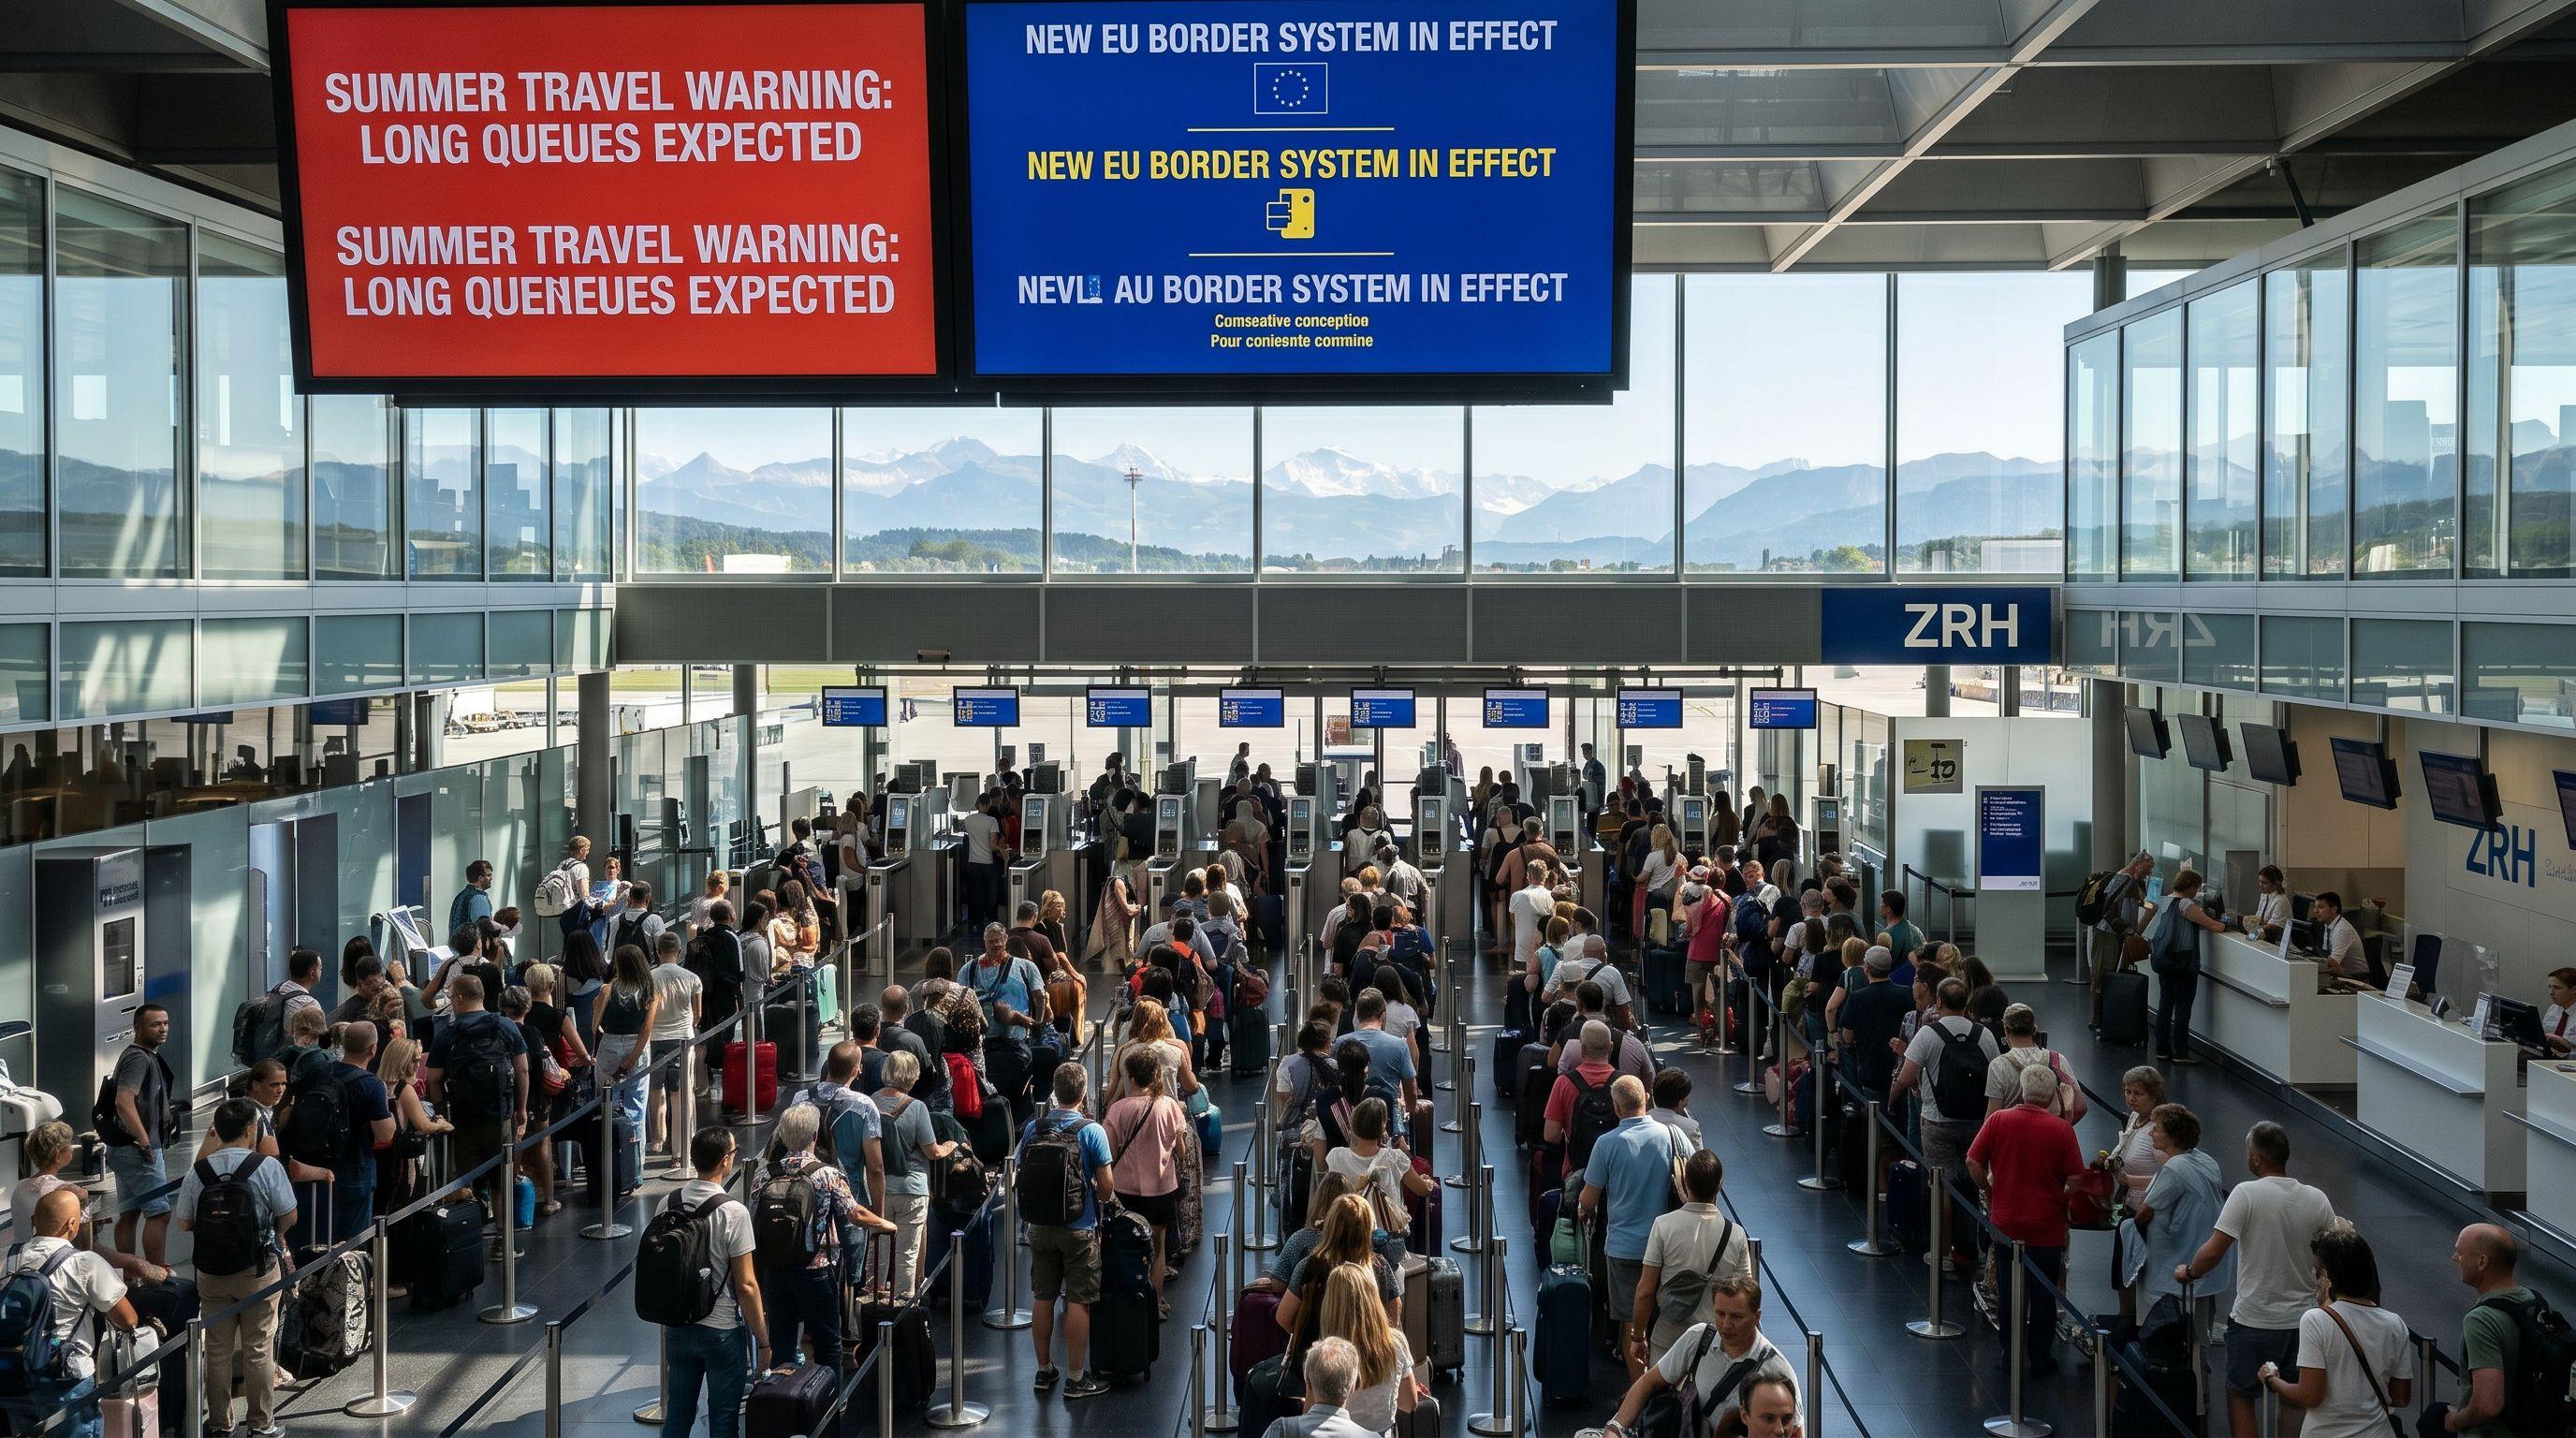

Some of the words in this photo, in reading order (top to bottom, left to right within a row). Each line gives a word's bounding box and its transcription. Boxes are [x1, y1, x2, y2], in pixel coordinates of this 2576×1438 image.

[1027, 23, 1092, 54] NEW
[1103, 23, 1139, 53] EU
[1149, 22, 1269, 53] BORDER
[1279, 22, 1398, 52] SYSTEM
[1410, 22, 1439, 51] IN
[1449, 21, 1558, 51] EFFECT
[325, 72, 507, 113] SUMMER
[518, 71, 674, 111] TRAVEL
[684, 69, 893, 110] WARNING:
[360, 124, 469, 165] LONG
[482, 123, 641, 168] QUEUES
[653, 121, 862, 162] EXPECTED
[1028, 151, 1094, 181] NEW
[1104, 150, 1140, 180] EU
[1149, 150, 1270, 180] BORDER
[1280, 149, 1399, 179] SYSTEM
[1409, 148, 1439, 178] IN
[1449, 147, 1557, 178] EFFECT
[336, 226, 518, 266] SUMMER
[527, 225, 684, 265] TRAVEL
[693, 223, 900, 264] WARNING:
[344, 276, 452, 316] LONG
[689, 274, 895, 315] EXPECTED
[1114, 275, 1153, 304] AU
[1164, 274, 1283, 304] BORDER
[1292, 273, 1411, 303] SYSTEM
[1421, 273, 1450, 302] IN
[1460, 272, 1569, 302] EFFECT
[1210, 334, 1242, 348] Pour
[1904, 603, 2018, 648] ZRH
[2466, 823, 2536, 888] ZRH
